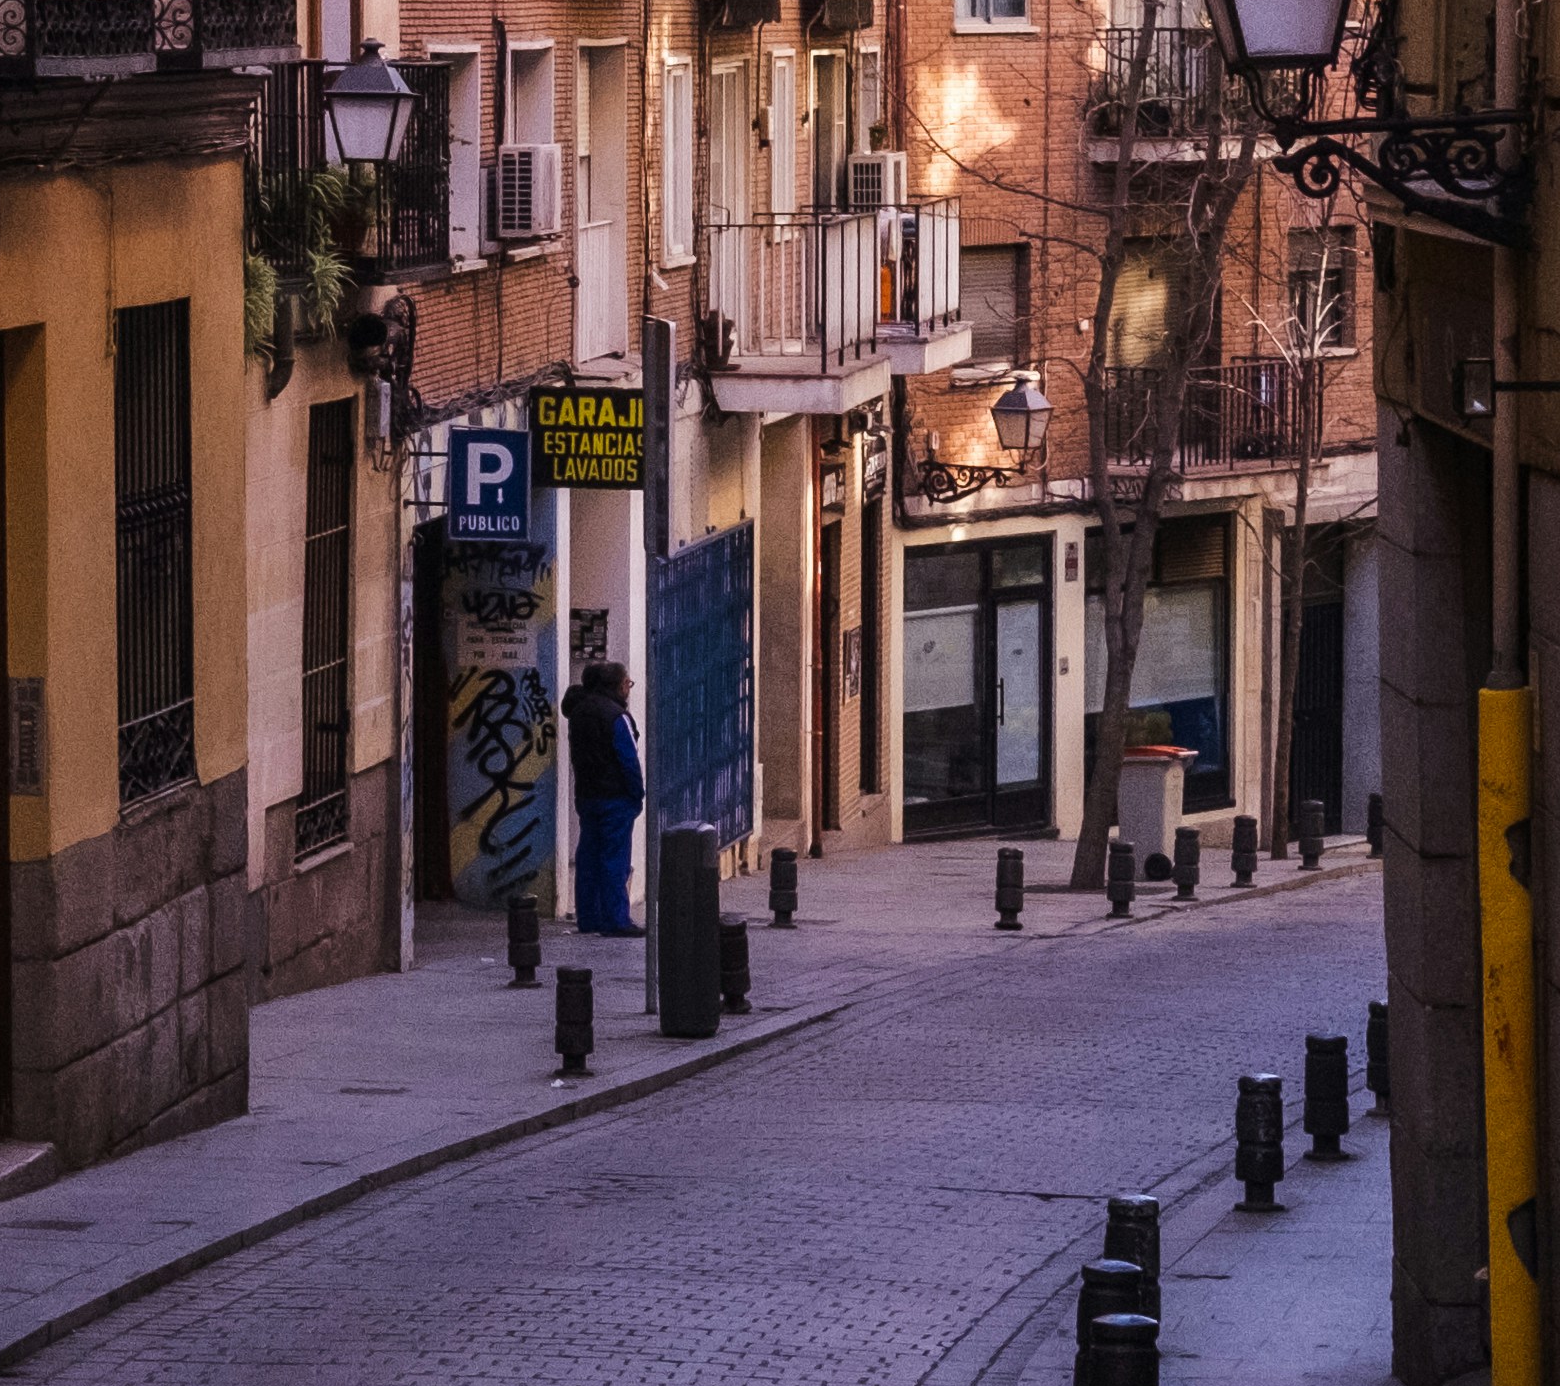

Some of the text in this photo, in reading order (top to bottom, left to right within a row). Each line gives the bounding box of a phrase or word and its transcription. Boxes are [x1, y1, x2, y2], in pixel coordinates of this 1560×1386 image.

[466, 442, 514, 505] P
[553, 457, 638, 482] LAVADOS
[458, 515, 520, 532] PUBLICO
